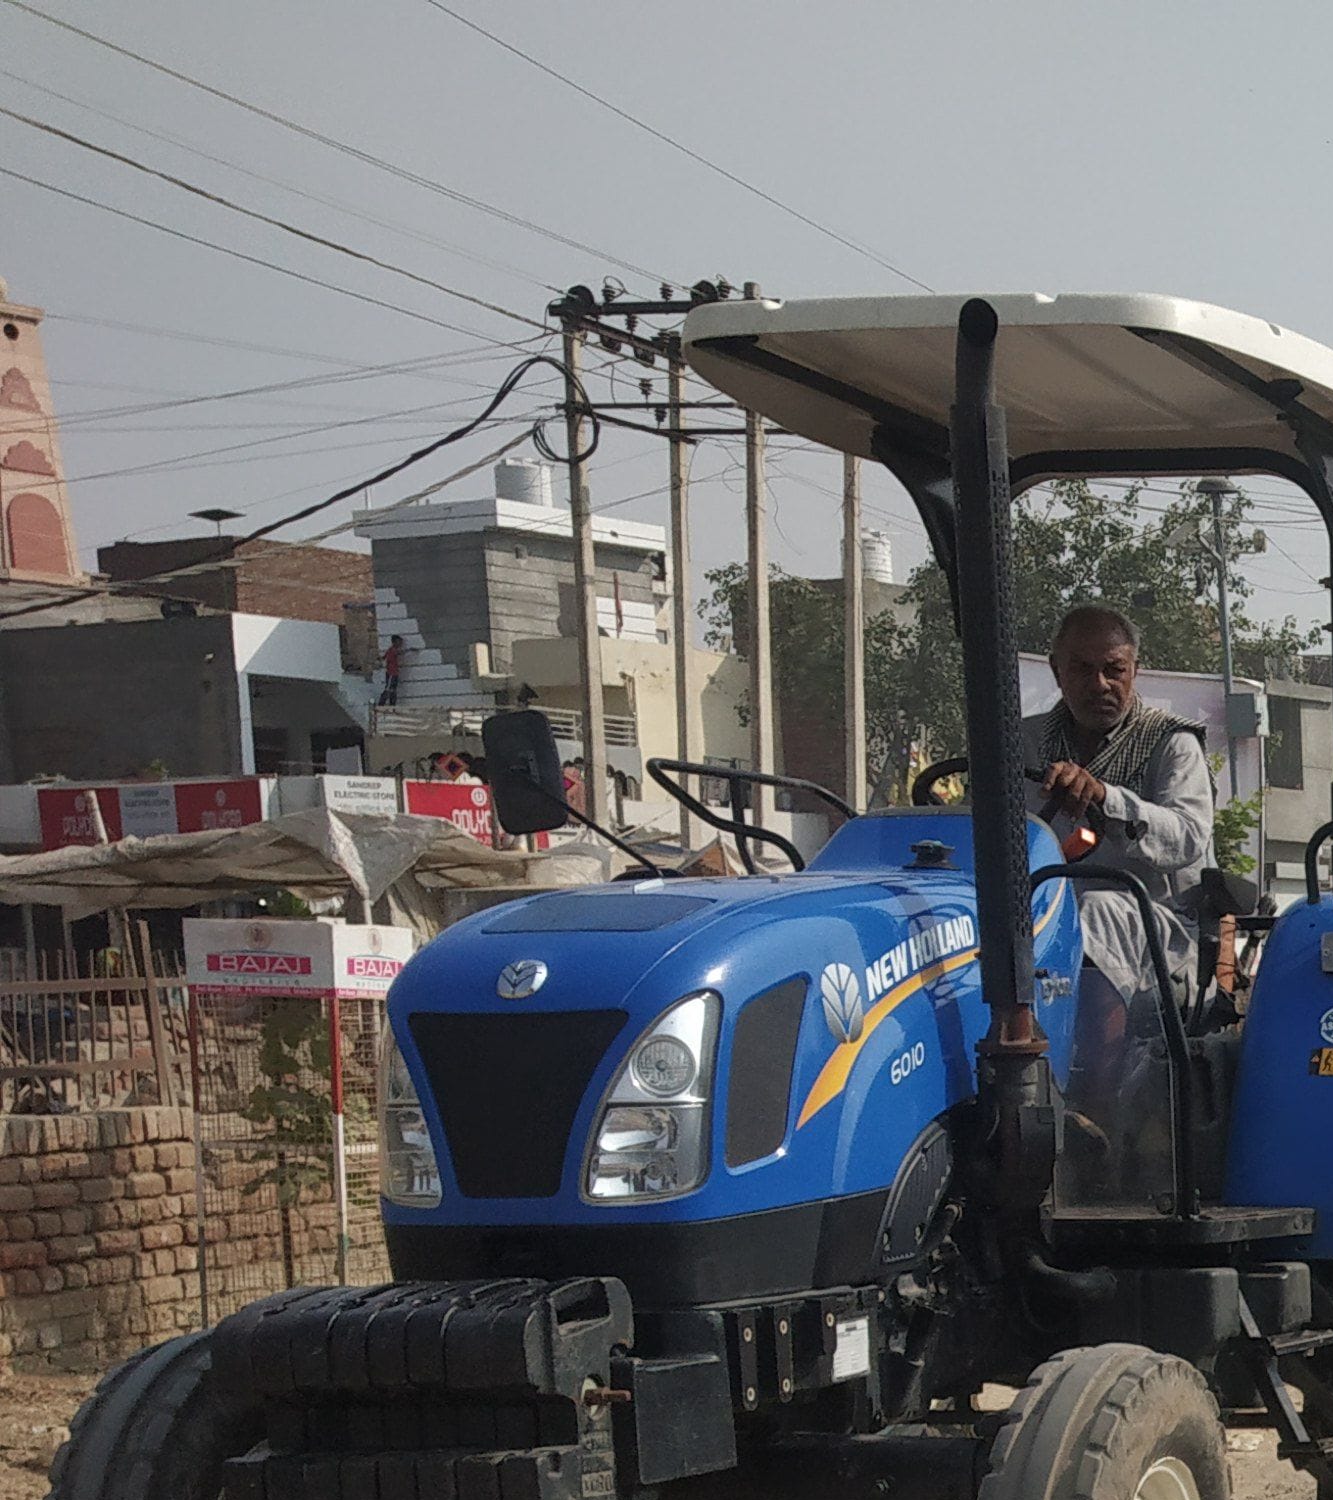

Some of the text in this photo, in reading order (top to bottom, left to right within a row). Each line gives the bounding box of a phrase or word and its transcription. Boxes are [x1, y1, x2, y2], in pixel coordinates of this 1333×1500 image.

[219, 956, 302, 974] BAJAJ
[866, 914, 975, 1002] NEW HOLLAND
[890, 1041, 925, 1085] 6010
